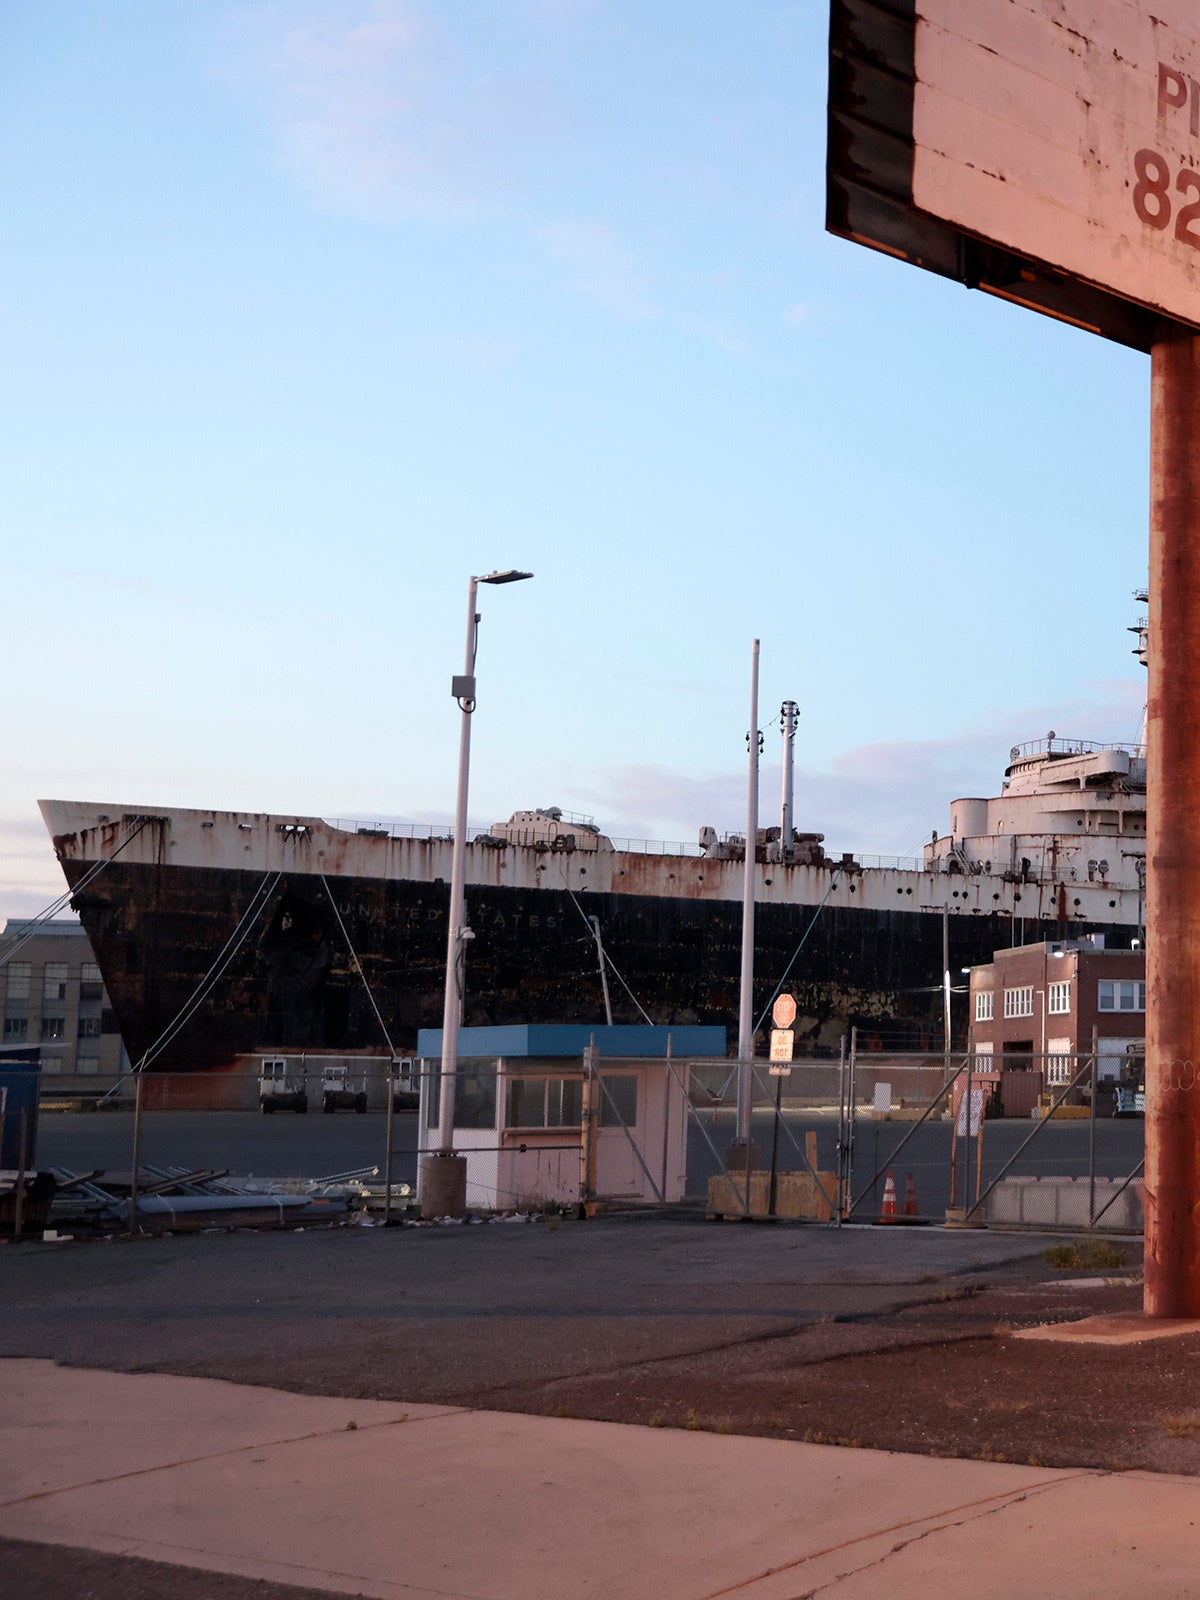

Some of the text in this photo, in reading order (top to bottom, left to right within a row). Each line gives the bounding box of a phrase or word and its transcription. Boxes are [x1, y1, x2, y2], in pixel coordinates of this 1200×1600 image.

[465, 911, 557, 928] TATES
[777, 1001, 793, 1012] STOP
[778, 1035, 787, 1045] DO
[773, 1048, 788, 1057] NOT
